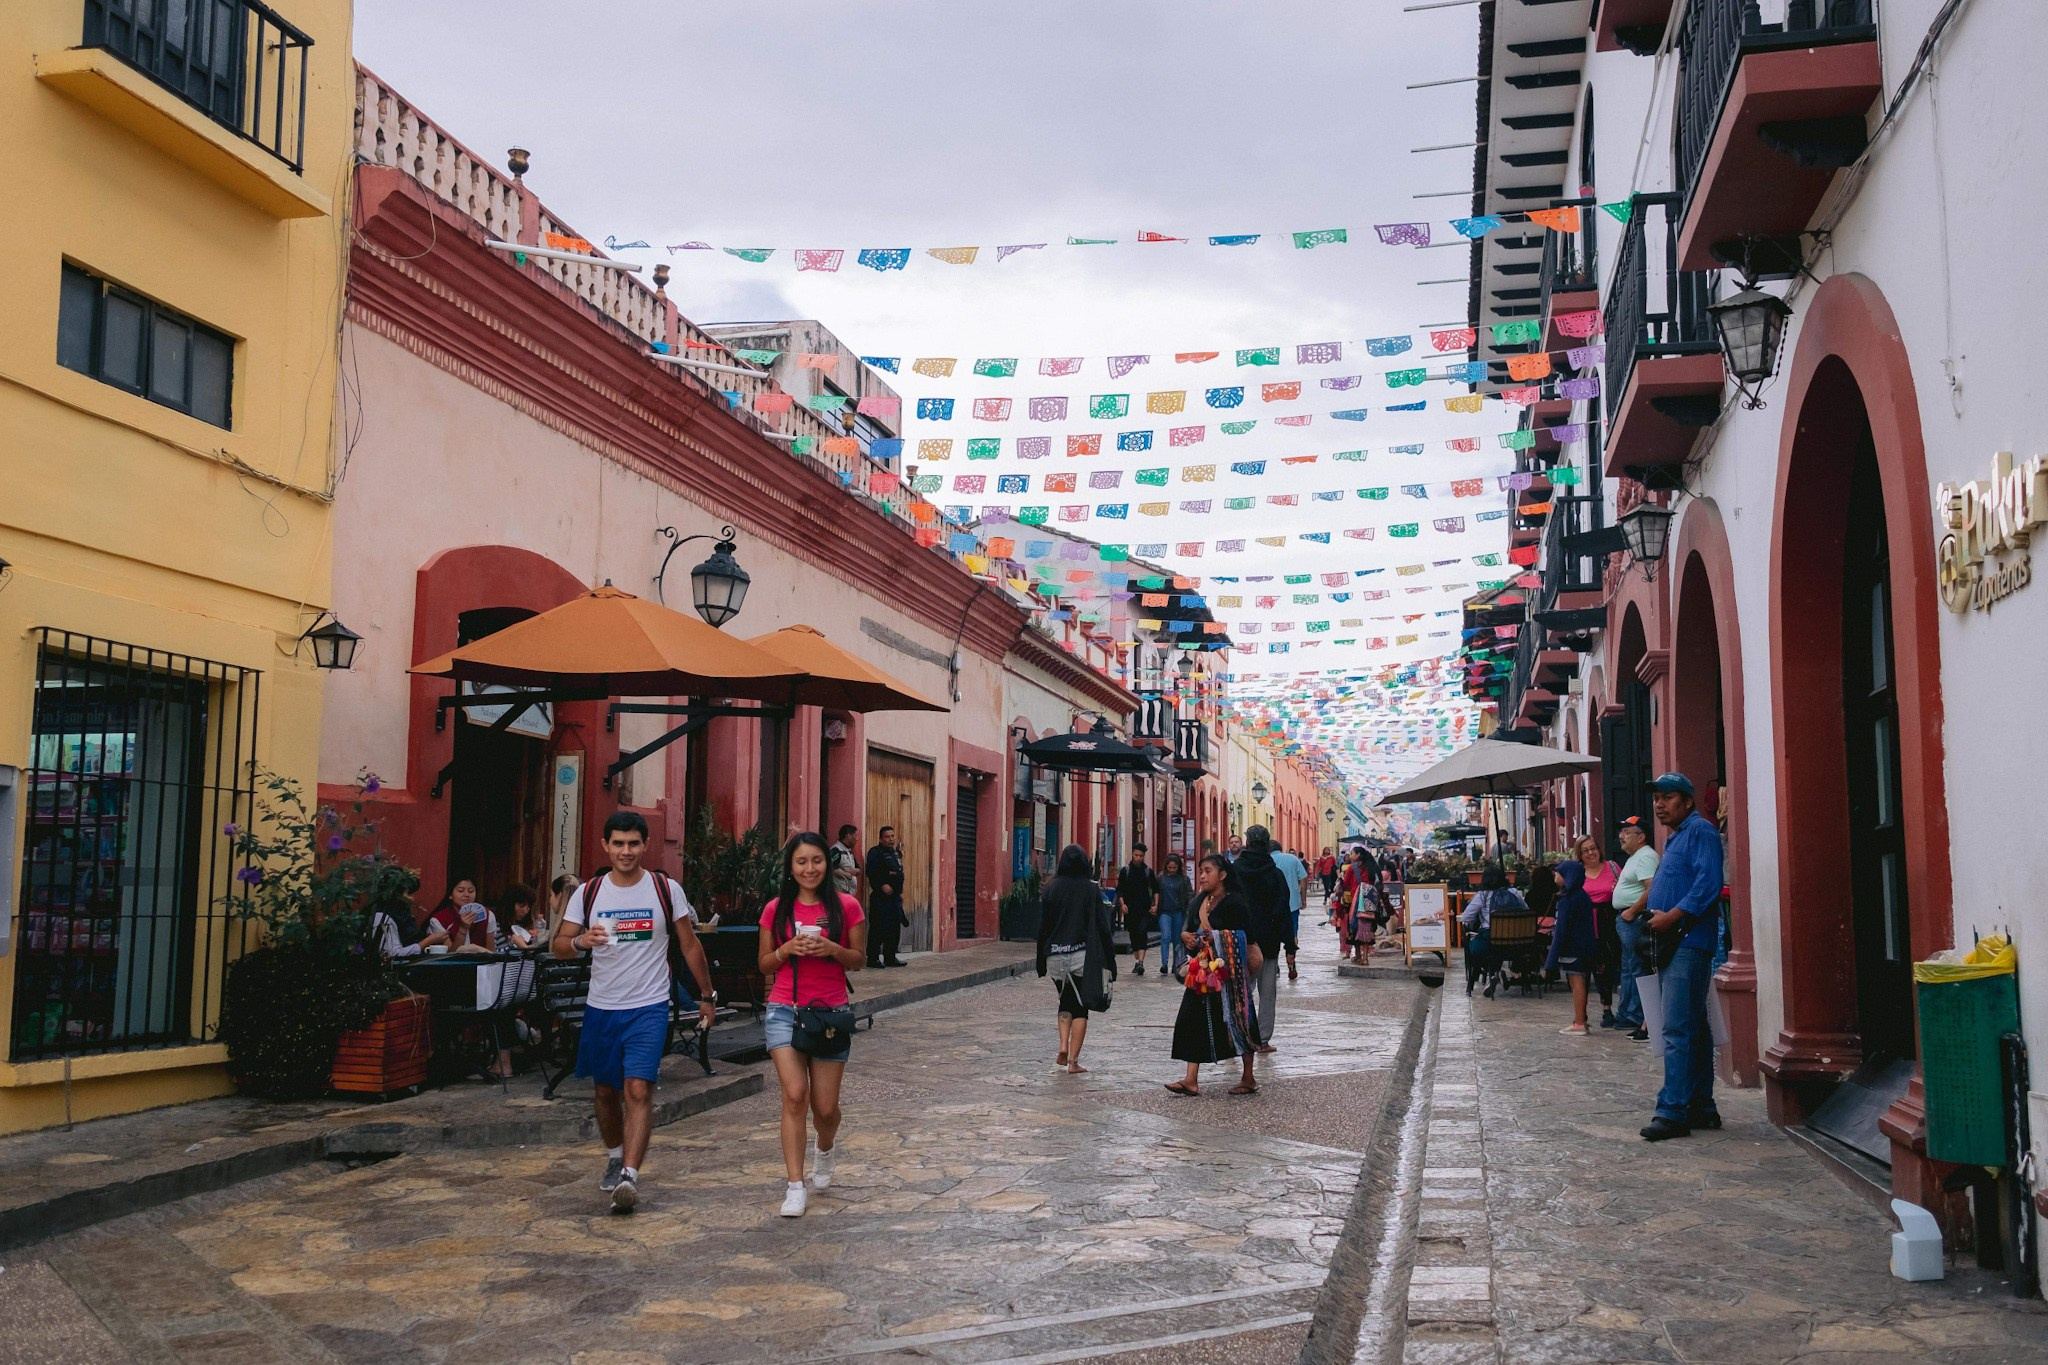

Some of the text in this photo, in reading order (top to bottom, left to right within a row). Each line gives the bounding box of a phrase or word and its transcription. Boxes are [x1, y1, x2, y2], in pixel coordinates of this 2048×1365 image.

[1959, 451, 2044, 567] Pakar
[610, 911, 651, 919] ARGENTINA
[617, 922, 637, 930] GUAY
[617, 933, 638, 941] RASIL
